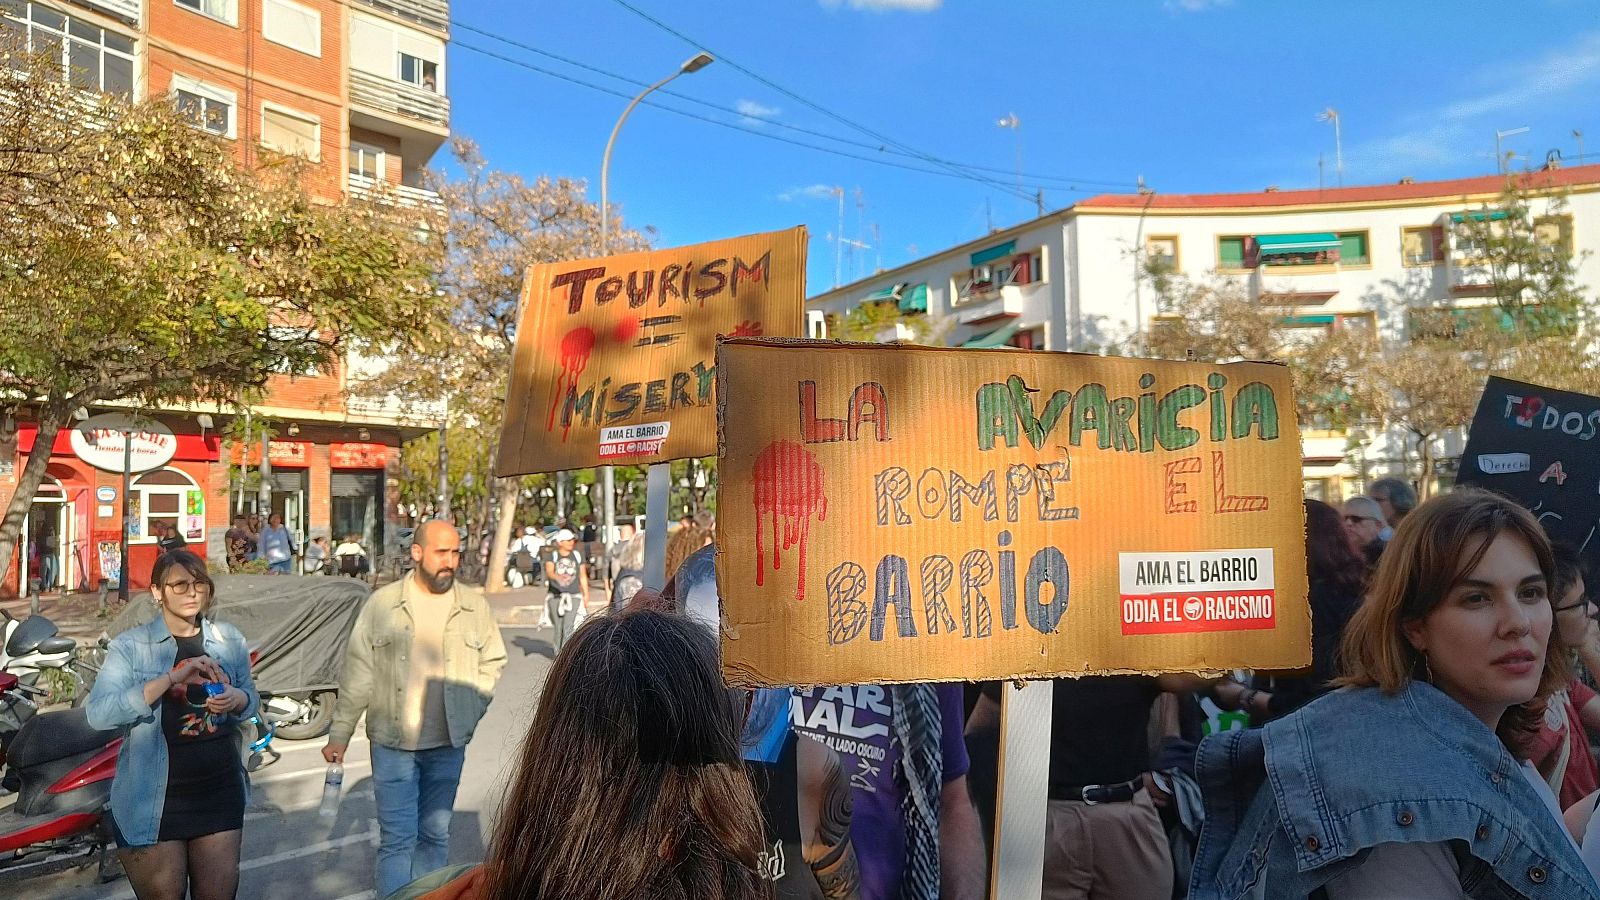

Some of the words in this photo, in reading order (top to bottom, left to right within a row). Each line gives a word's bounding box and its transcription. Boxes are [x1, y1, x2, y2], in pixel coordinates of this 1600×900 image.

[550, 250, 771, 314] TOURISM
[798, 380, 892, 444] LA
[976, 373, 1279, 453] AVARICIA
[607, 430, 623, 440] AMA
[626, 429, 634, 438] EL
[636, 425, 664, 438] BARRIO
[600, 445, 616, 456] ODIA
[617, 443, 626, 453] EL
[1539, 460, 1567, 486] A
[875, 456, 1079, 526] ROMPE
[1164, 451, 1269, 514] EL
[1135, 560, 1172, 586] AMA
[1177, 560, 1195, 584] EL
[1200, 556, 1257, 583] BARRIO
[826, 530, 1070, 646] BARRIO
[1123, 599, 1160, 623] ODIA
[1163, 597, 1182, 622] EL
[1205, 595, 1272, 620] RACISMO
[825, 736, 835, 750] AL
[835, 738, 857, 754] LADO
[856, 743, 885, 761] OSCURO
